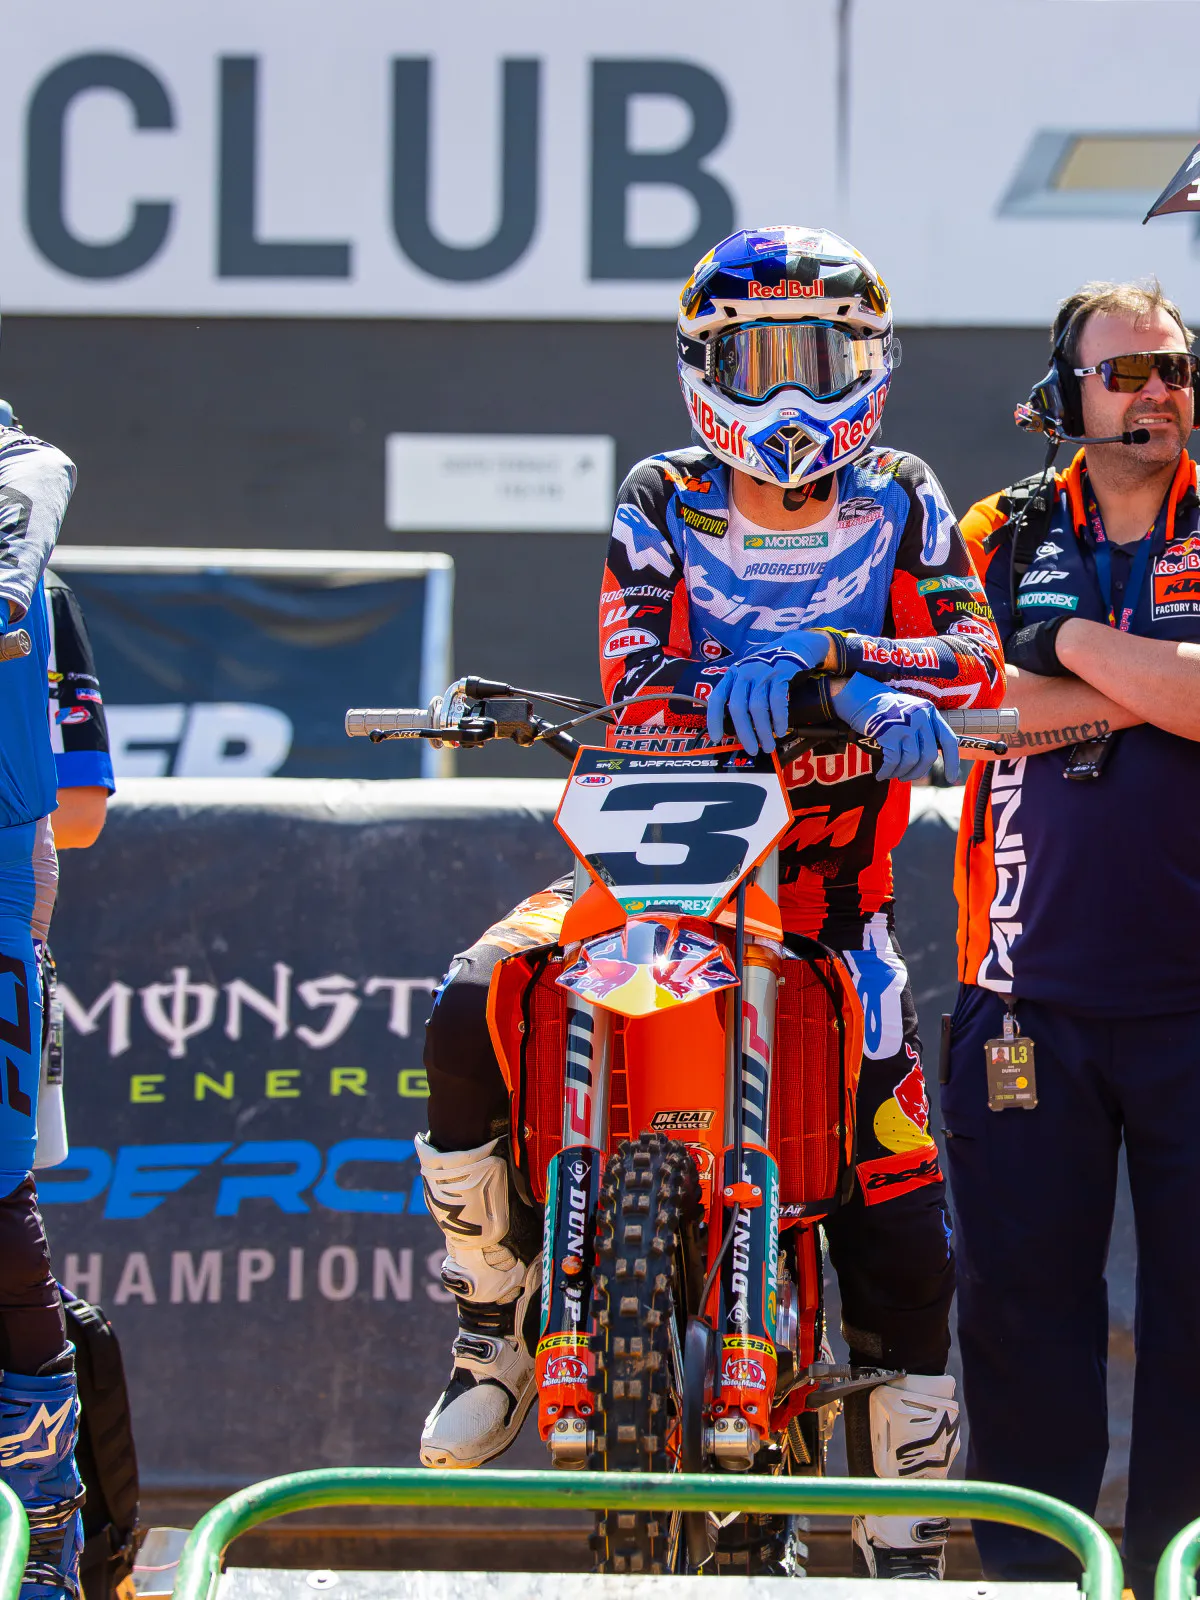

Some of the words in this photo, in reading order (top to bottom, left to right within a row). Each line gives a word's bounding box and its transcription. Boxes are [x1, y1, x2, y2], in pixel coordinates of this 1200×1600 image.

[23, 48, 738, 284] CLUB
[748, 280, 786, 299] Red
[787, 280, 825, 298] Bull
[700, 400, 748, 460] Bull
[830, 392, 875, 461] Red
[764, 534, 825, 549] MOTOREX
[742, 561, 828, 579] PROGRESSIVE
[1156, 559, 1187, 575] Red
[601, 584, 674, 605] ROGRESSIVE
[1020, 592, 1073, 608] MOTOREX
[1155, 603, 1191, 615] FACTORY
[609, 636, 650, 651] BELL
[863, 640, 902, 666] Red
[899, 647, 940, 670] Bull
[629, 759, 719, 768] SUPERCROSS
[582, 776, 606, 785] AMA
[584, 781, 768, 887] 3
[645, 900, 711, 912] MOTOREX
[56, 961, 437, 1058] MONST
[1011, 1046, 1028, 1064] L3
[130, 1067, 431, 1103] ENERG
[656, 1112, 710, 1124] DECAL
[65, 1246, 456, 1305] HAMPIONS
